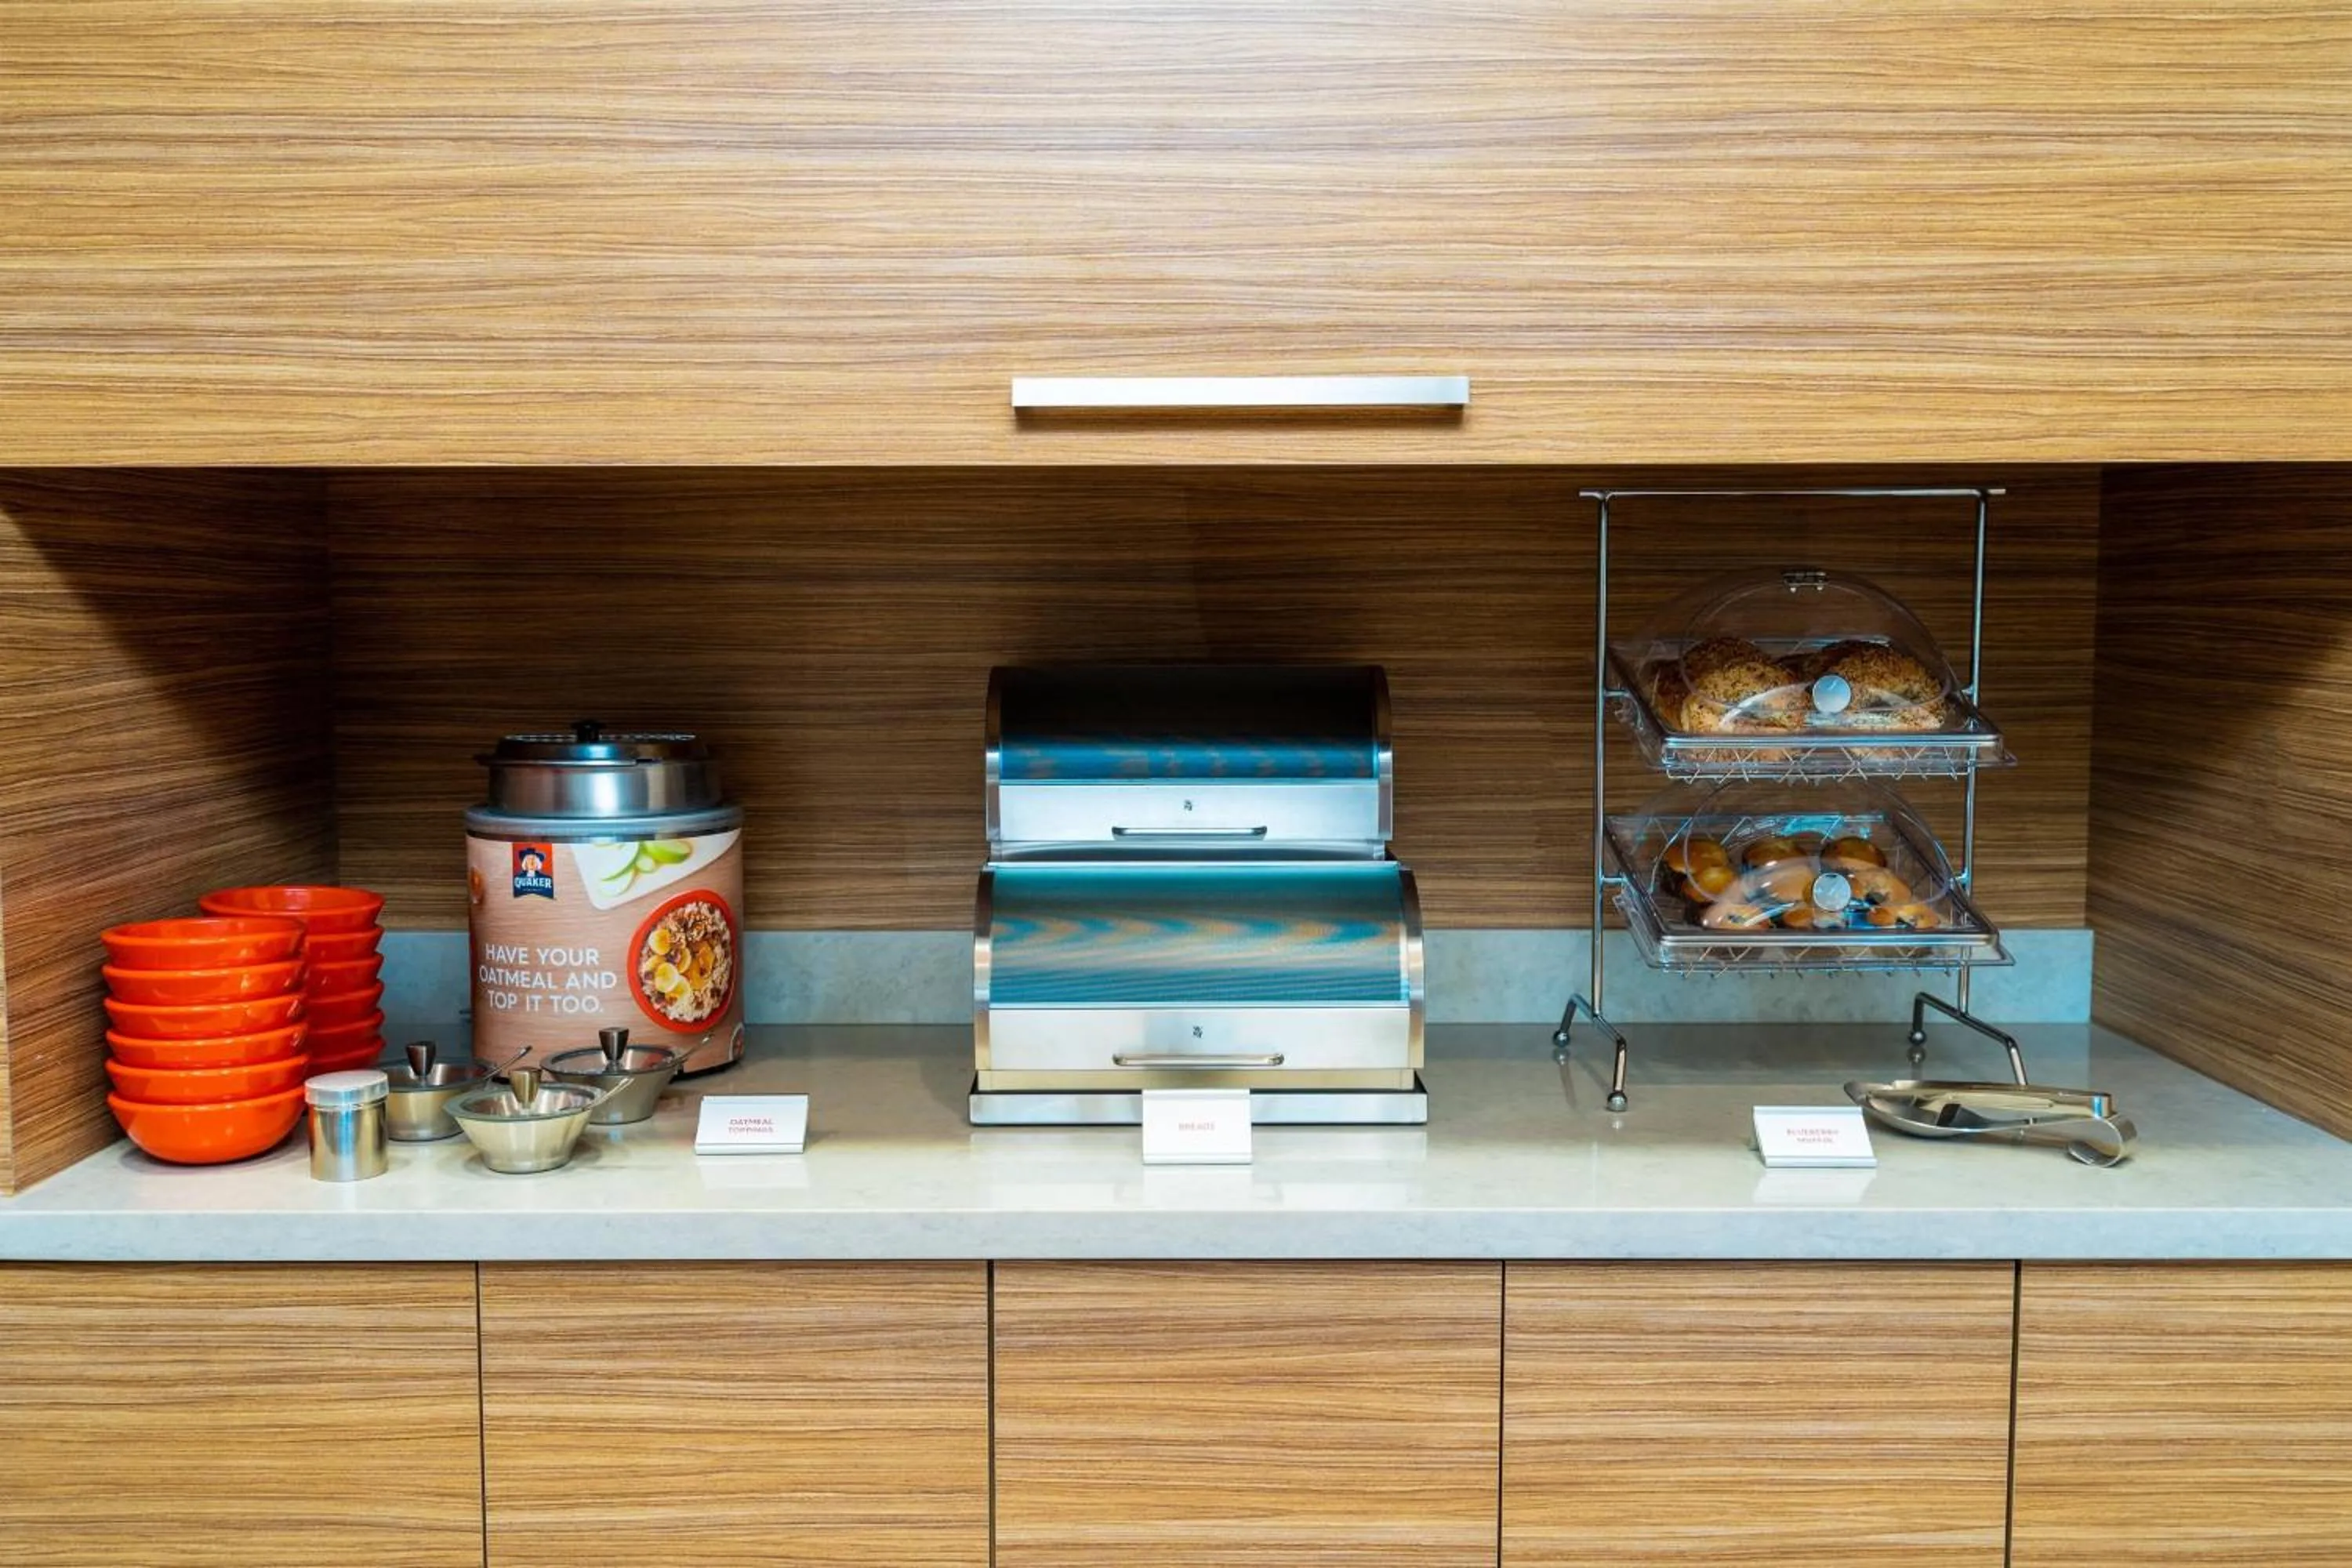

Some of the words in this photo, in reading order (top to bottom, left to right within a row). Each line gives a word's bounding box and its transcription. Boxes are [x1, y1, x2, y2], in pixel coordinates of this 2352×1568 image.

[514, 877, 552, 888] QUAKER
[485, 944, 529, 964] HAVE
[537, 948, 600, 966] YOUR
[479, 965, 557, 989] OATMEAL
[565, 971, 618, 989] AND
[488, 989, 517, 1009] TOP
[526, 994, 543, 1012] IT
[550, 994, 604, 1014] TOO.
